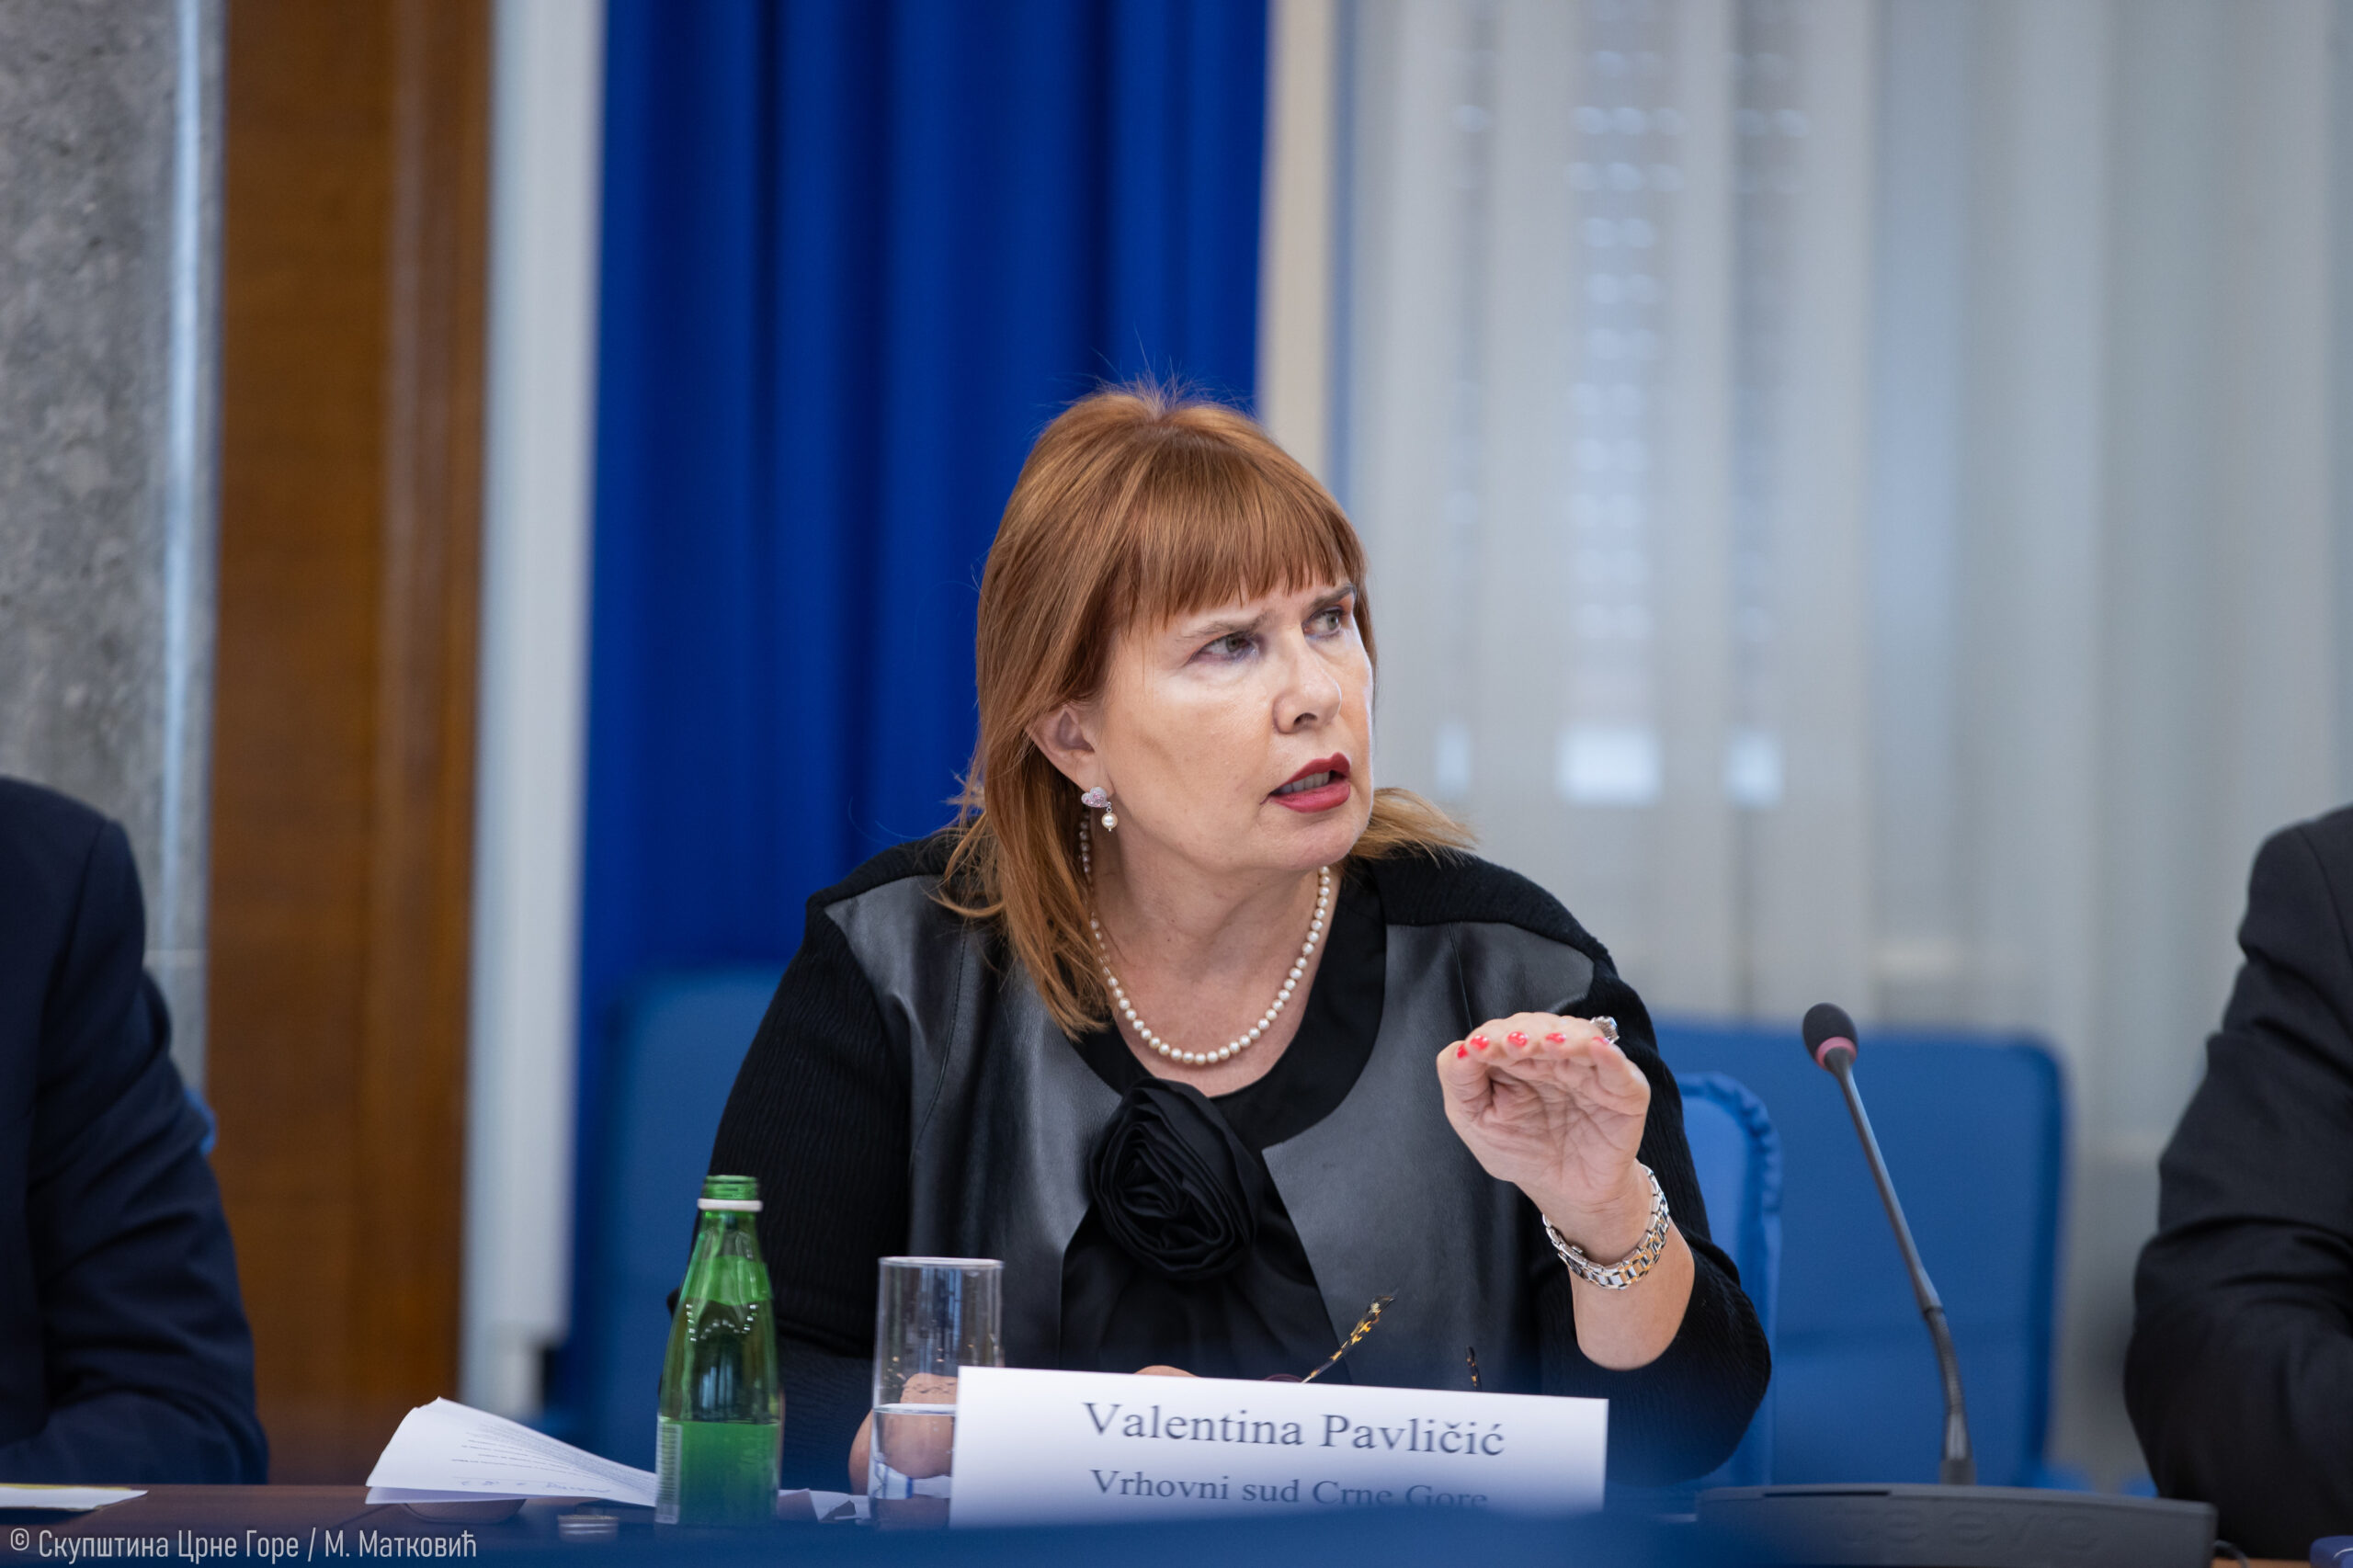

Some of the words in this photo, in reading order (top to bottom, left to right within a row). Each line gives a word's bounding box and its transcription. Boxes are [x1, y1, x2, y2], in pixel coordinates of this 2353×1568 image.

[1082, 1402, 1305, 1446] Valentina
[1318, 1414, 1506, 1457] Pavličić
[1089, 1469, 1230, 1500] Vrhovni
[1241, 1478, 1301, 1504] sud
[1312, 1480, 1392, 1506] Crne
[1404, 1484, 1489, 1508] Gore
